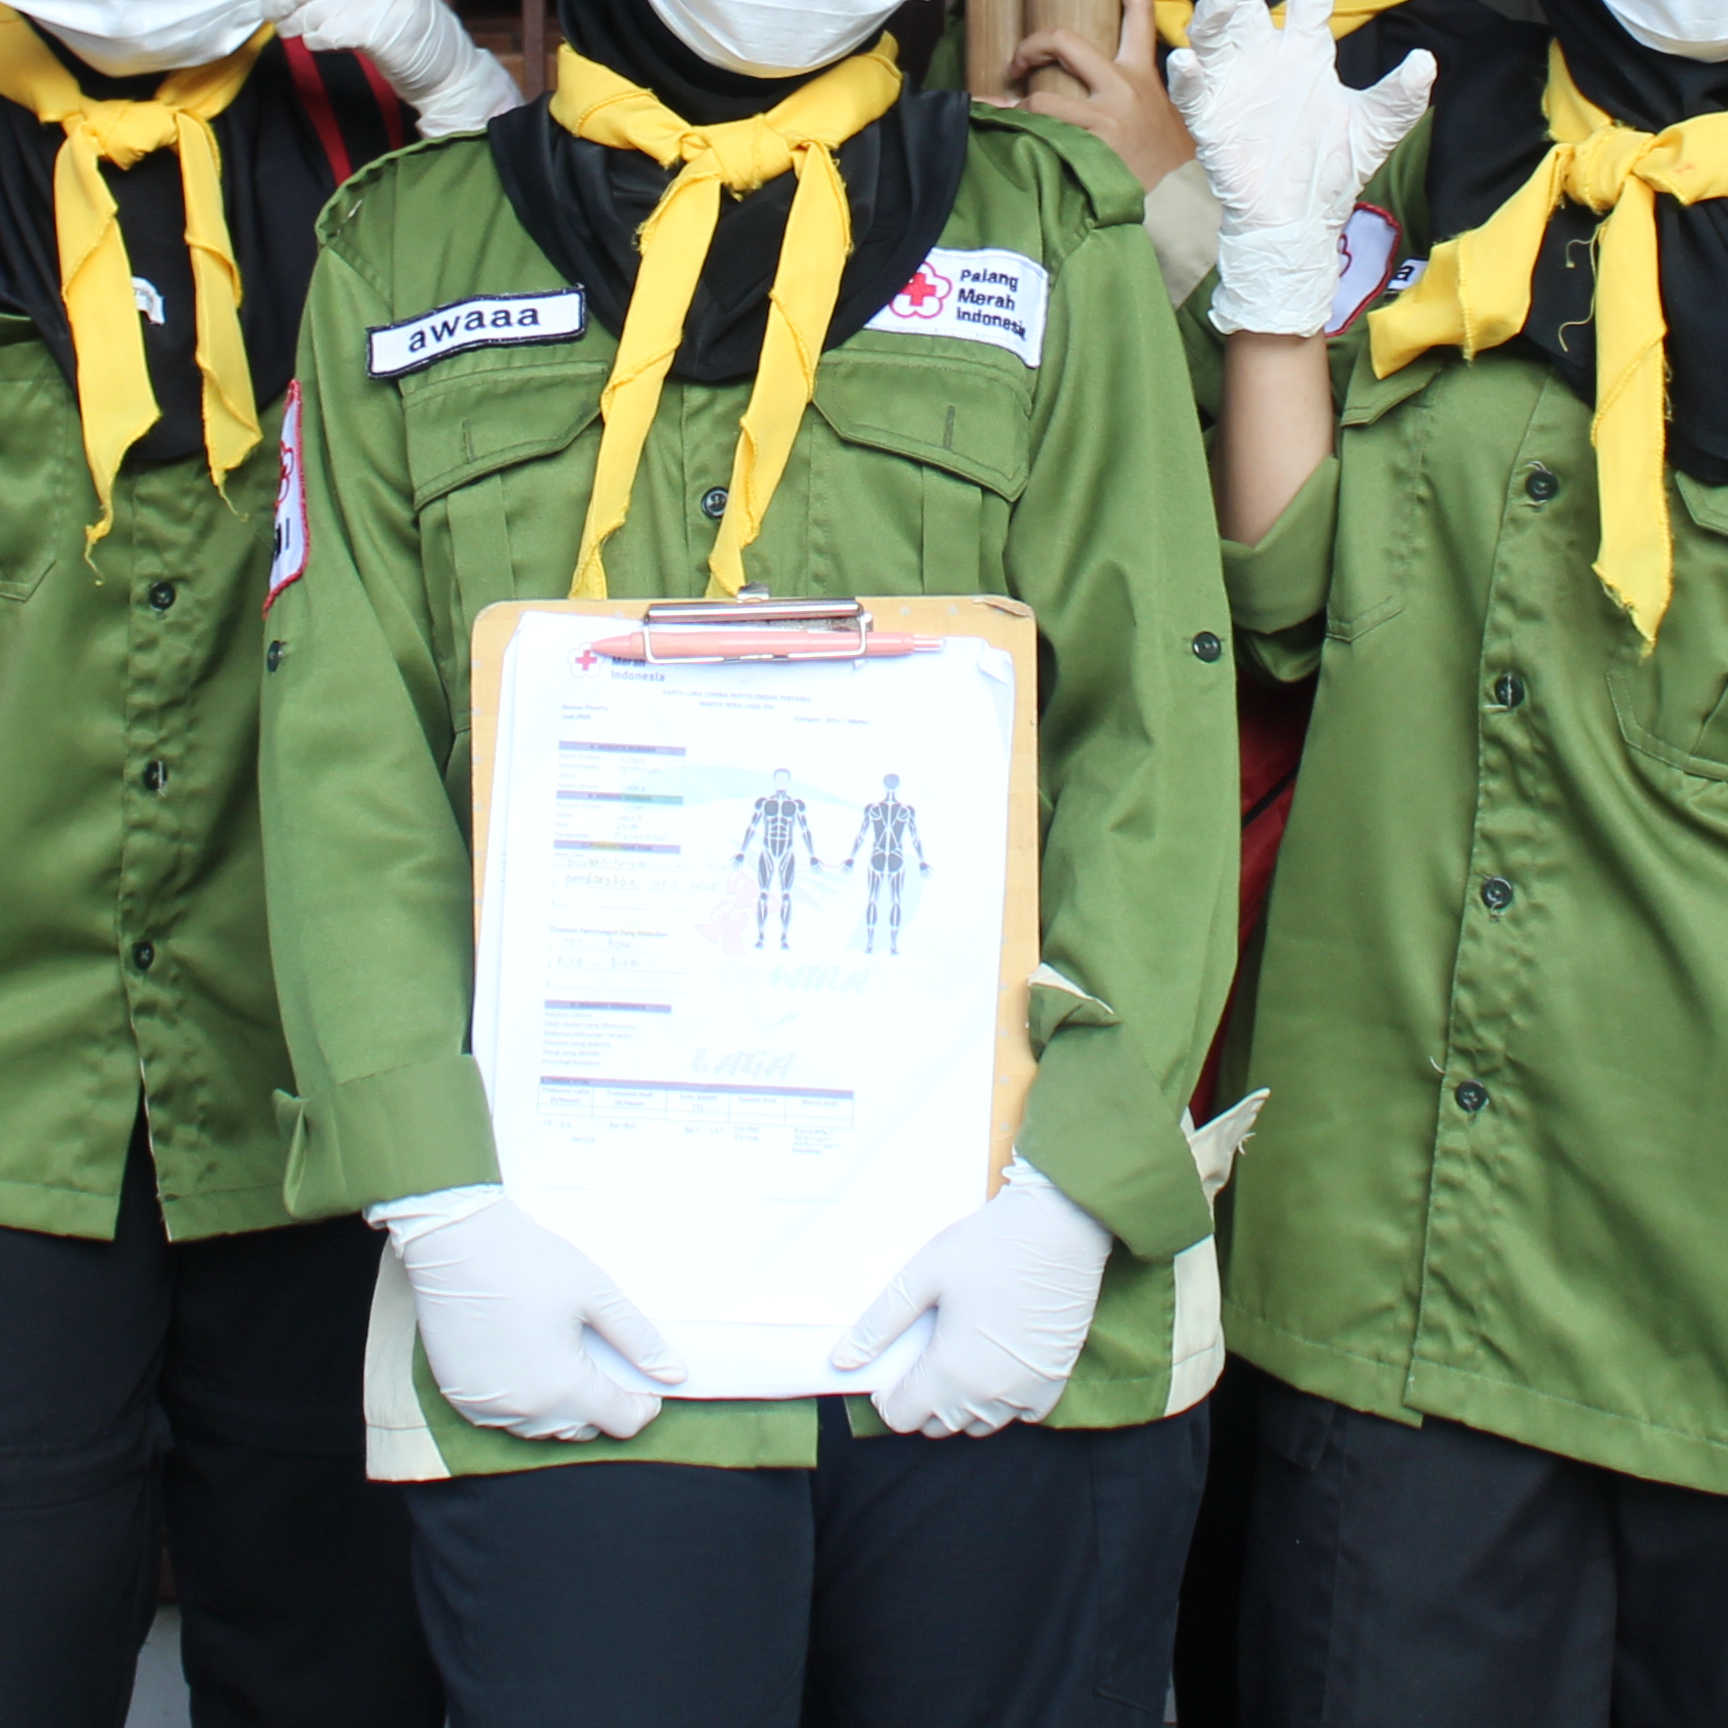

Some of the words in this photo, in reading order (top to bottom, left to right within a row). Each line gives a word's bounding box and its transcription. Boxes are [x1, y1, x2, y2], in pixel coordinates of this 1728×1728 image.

[960, 268, 1019, 292] Palang
[957, 287, 1015, 312] Merah
[408, 302, 542, 353] awaaa
[956, 306, 1026, 342] Indonesia
[610, 669, 666, 682] Indonesia
[691, 1047, 795, 1079] LAGA
